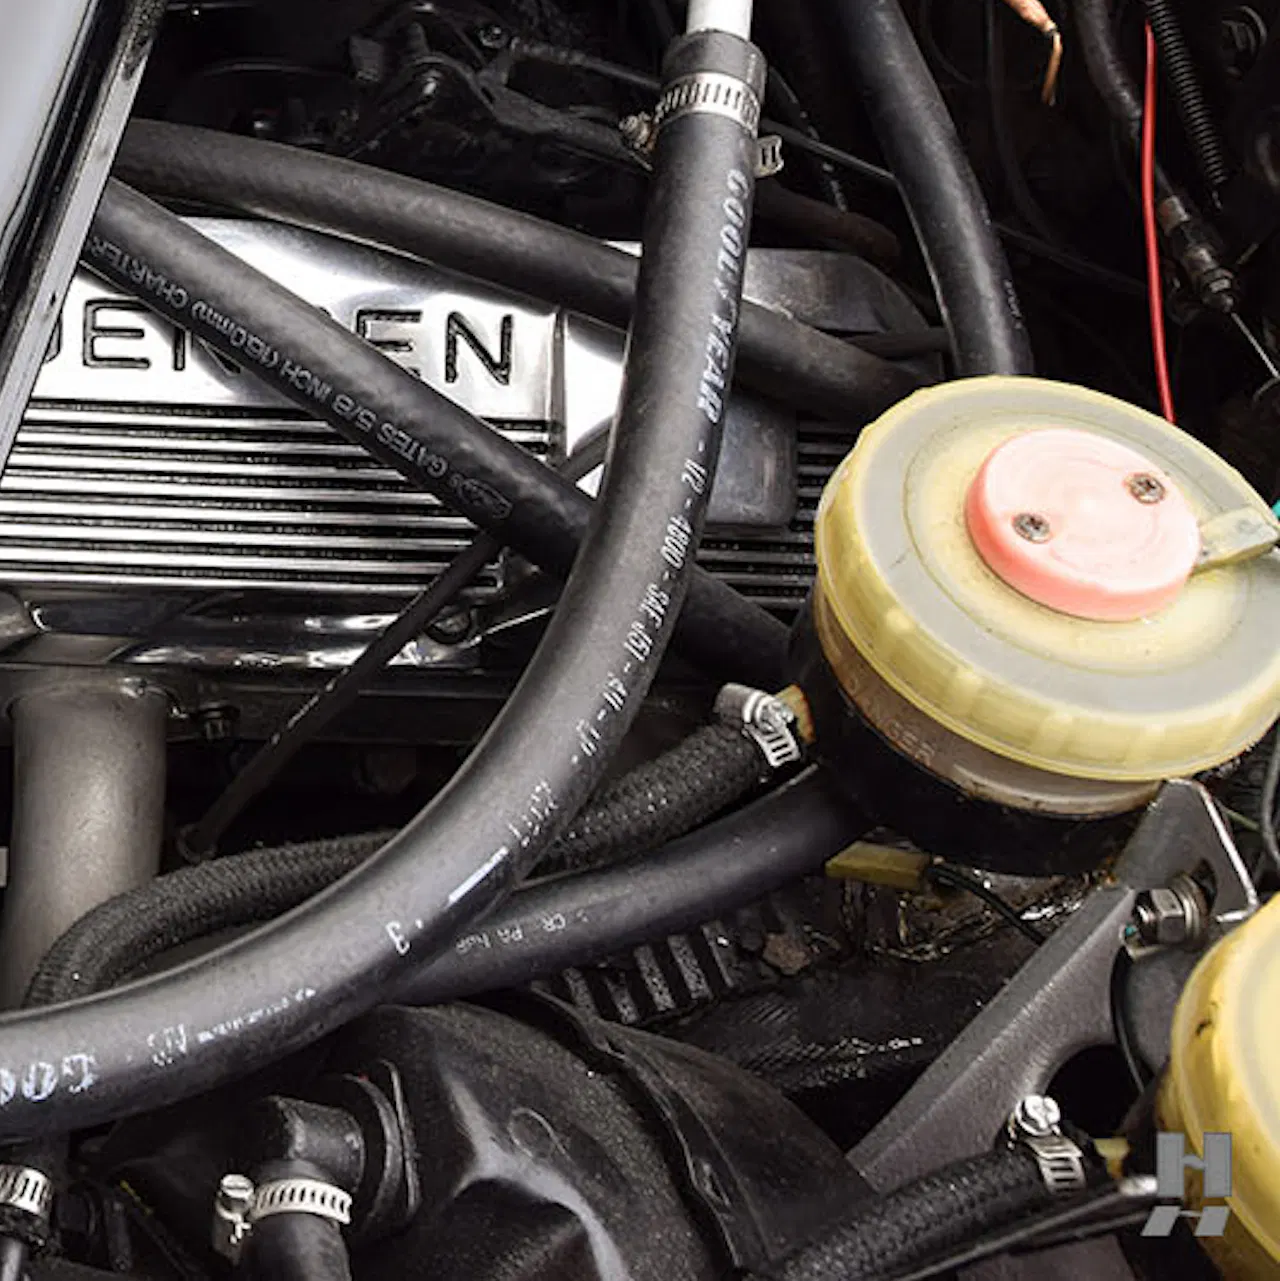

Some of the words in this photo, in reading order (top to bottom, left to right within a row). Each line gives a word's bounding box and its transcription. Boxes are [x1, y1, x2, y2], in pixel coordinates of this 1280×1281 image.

[42, 297, 514, 387] EEN
[280, 359, 333, 402] INCH
[331, 394, 378, 433] 5/8
[376, 422, 449, 478] GATES
